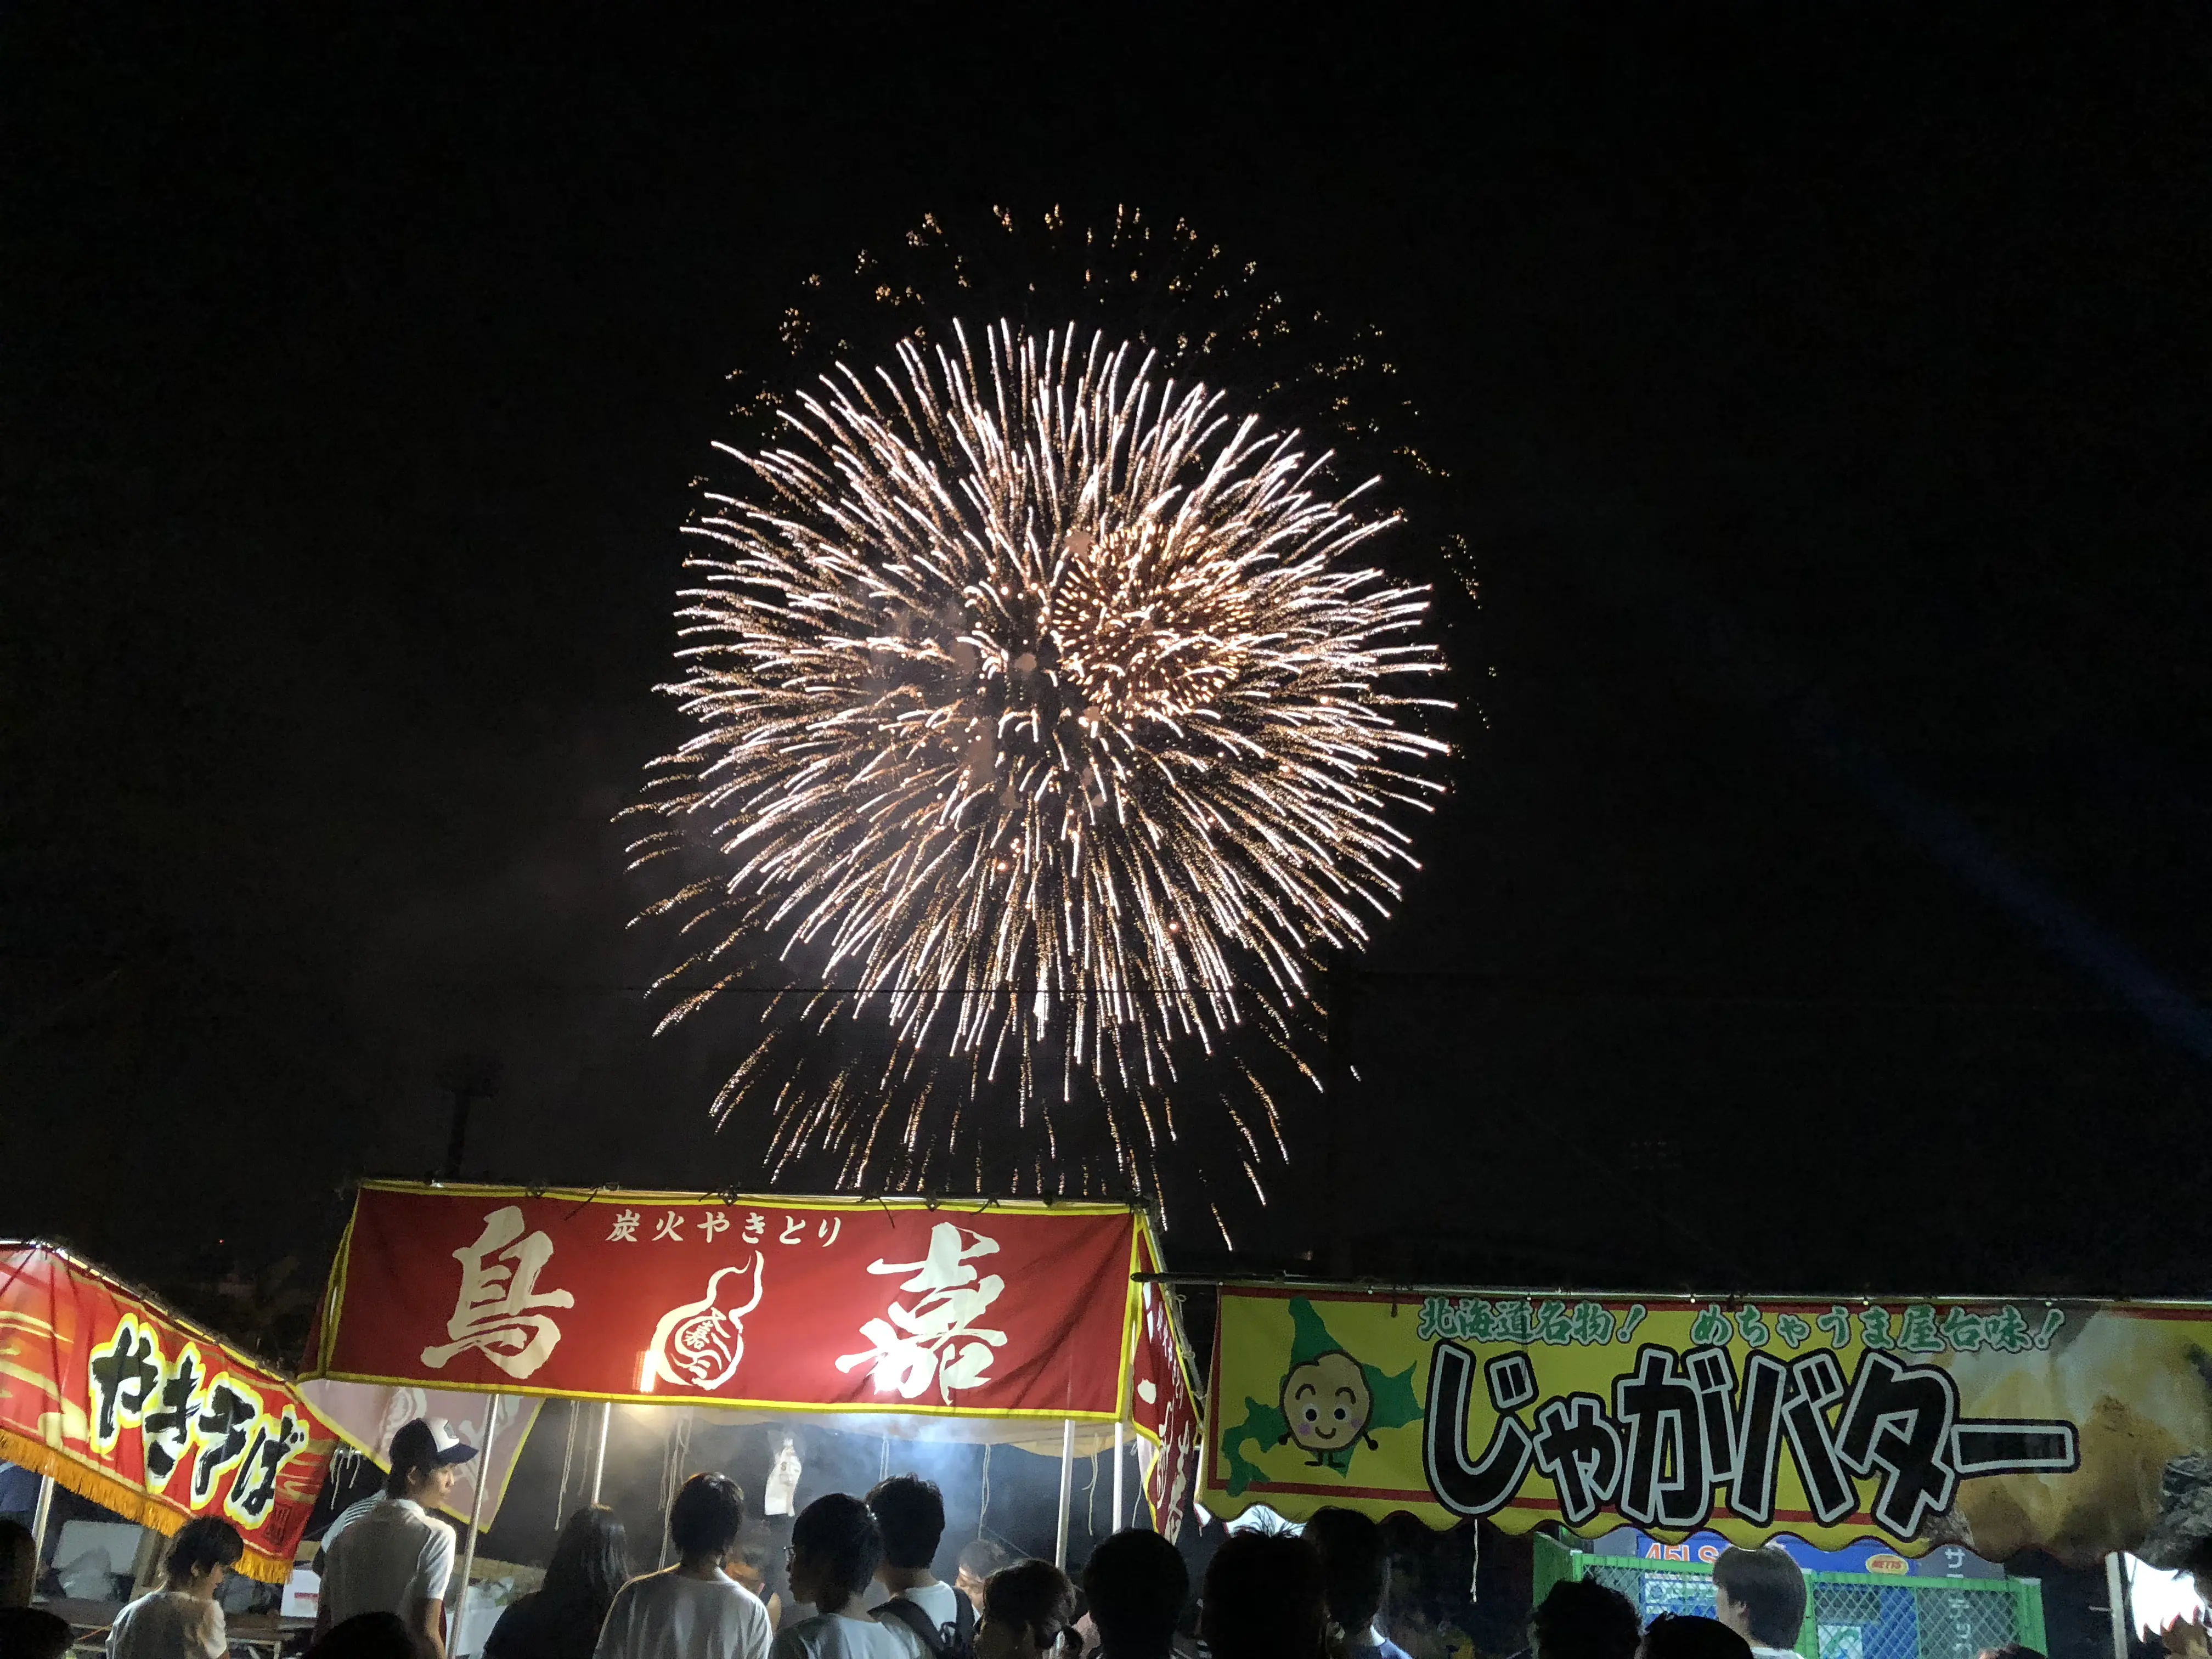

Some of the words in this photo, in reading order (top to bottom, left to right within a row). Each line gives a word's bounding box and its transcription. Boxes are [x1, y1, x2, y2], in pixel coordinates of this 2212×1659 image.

[605, 1209, 840, 1246] 炭火やきとり
[1417, 1296, 1646, 1346] 北海道名物!
[89, 1314, 308, 1528] やきそば
[1423, 1340, 2079, 1540] じゃがバター
